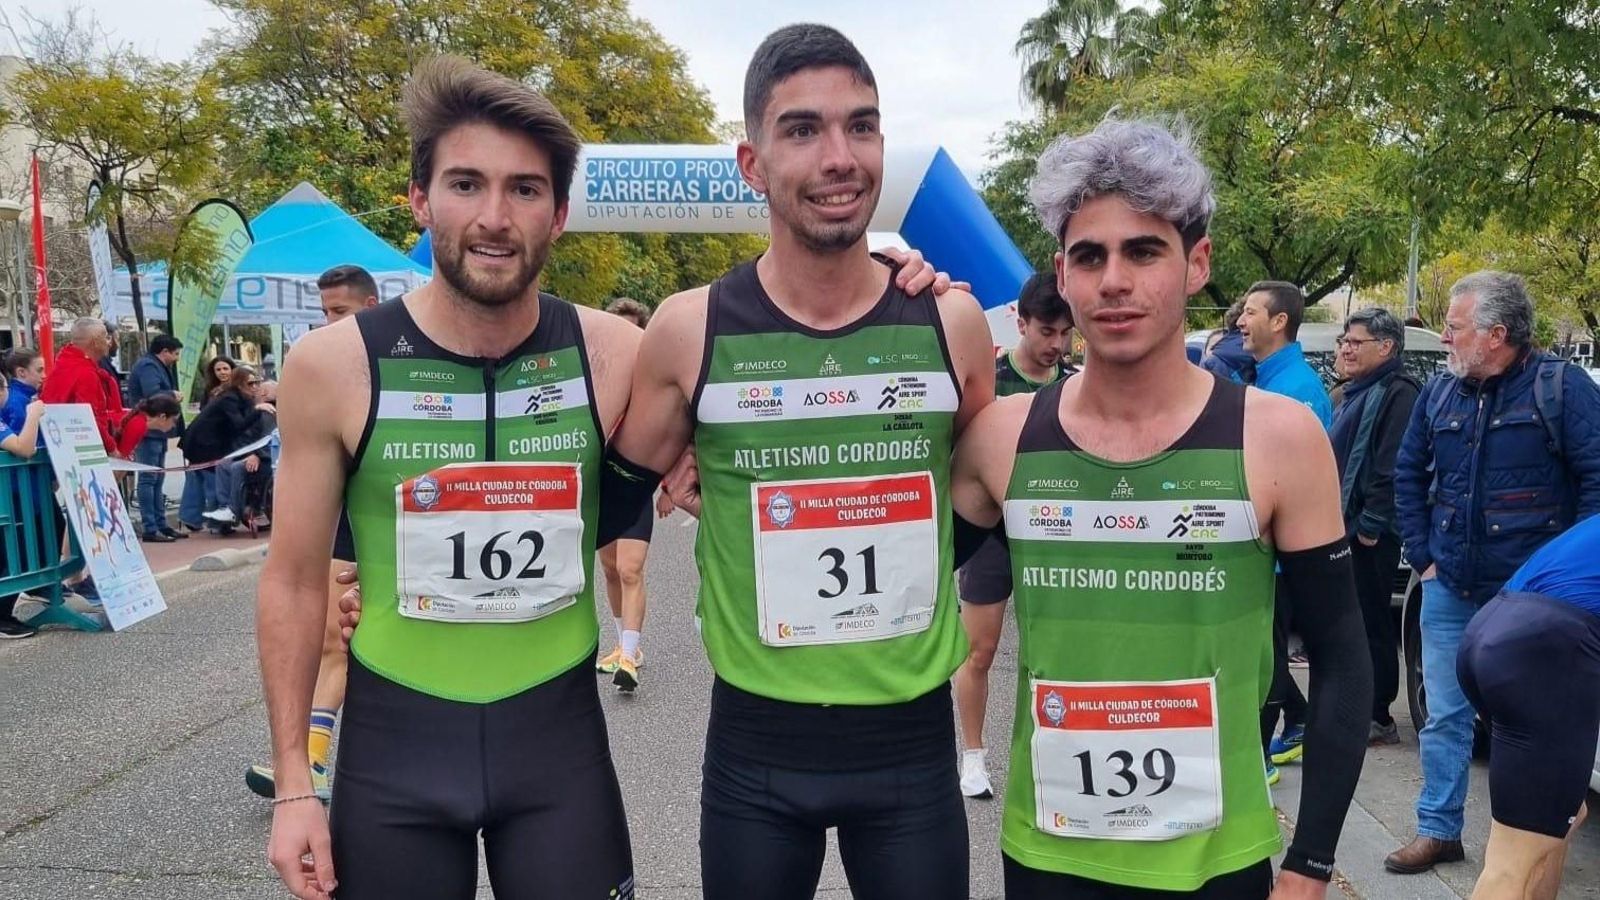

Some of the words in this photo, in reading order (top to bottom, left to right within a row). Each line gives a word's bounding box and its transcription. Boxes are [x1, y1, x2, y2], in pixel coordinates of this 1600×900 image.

[585, 160, 676, 179] CIRCUITO
[684, 160, 743, 179] PROV
[586, 179, 700, 201] CARRERAS
[587, 202, 699, 219] DIPUTACIÓN
[712, 206, 734, 219] DE
[744, 360, 787, 371] IMDECO
[419, 371, 455, 381] IMDECO
[803, 390, 856, 406] AOSSA
[382, 442, 476, 460] ATLETISMO
[508, 428, 588, 456] CORDOBÉS
[734, 444, 830, 470] ATLETISMO
[837, 434, 932, 465] CORDOBÉS
[454, 482, 481, 491] MILLA
[482, 481, 515, 492] CIUDAD
[516, 480, 528, 490] DE
[1038, 479, 1079, 489] IMDECO
[1176, 480, 1196, 490] LSC
[484, 493, 534, 505] CULDECOR
[807, 497, 834, 509] MILLA
[835, 495, 869, 507] CIUDAD
[870, 494, 881, 505] DE
[837, 507, 888, 521] CULDECOR
[1093, 515, 1146, 529] AOSSA
[444, 530, 547, 580] 162
[817, 544, 883, 598] 31
[1022, 566, 1118, 590] ATLETISMO
[1125, 566, 1227, 592] CORDOBÉS
[1077, 700, 1105, 711] MILLA
[1106, 700, 1140, 711] CIUDAD
[1141, 699, 1152, 710] DE
[1108, 712, 1161, 725] CULDECOR
[1072, 748, 1177, 798] 139
[1116, 818, 1149, 828] IMDECO
